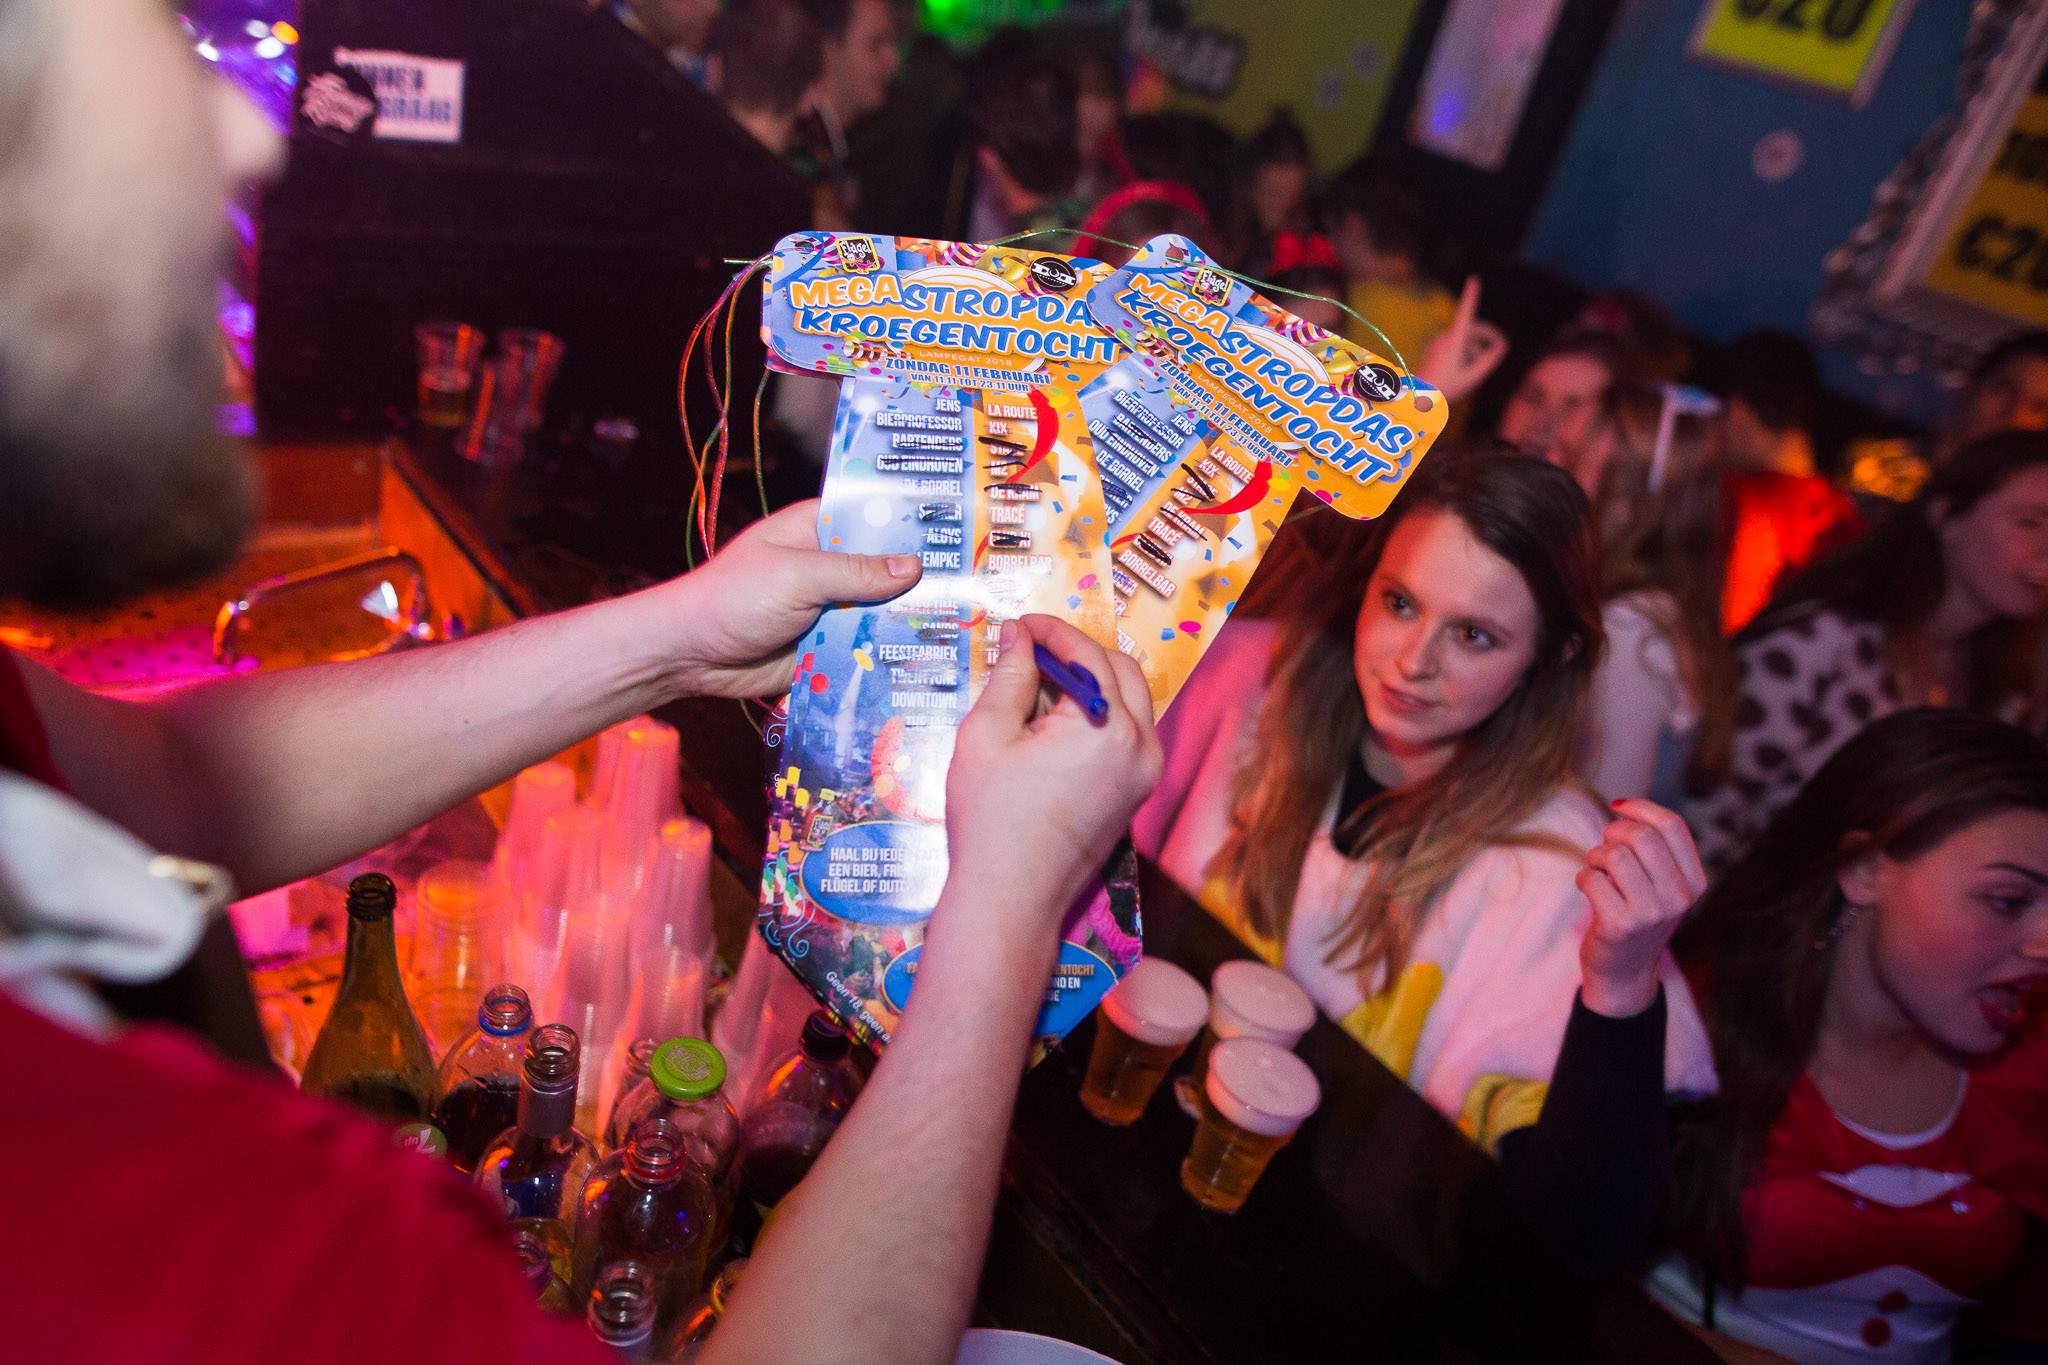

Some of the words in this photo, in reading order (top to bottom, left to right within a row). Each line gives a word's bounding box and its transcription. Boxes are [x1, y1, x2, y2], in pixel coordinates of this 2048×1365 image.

[789, 275, 1095, 329] MEGASTROPDA
[799, 308, 1119, 363] KROEGENTOCHT
[919, 350, 981, 364] LAMPEGAT
[985, 356, 1013, 367] 2018
[885, 357, 950, 375] ZONDAG
[954, 364, 970, 377] 11
[973, 366, 1051, 385] FEBRUARI
[911, 373, 932, 382] VAN
[959, 378, 978, 387] TOT
[1008, 383, 1030, 393] UUR
[1117, 289, 1394, 485] KROEGENTOCHT
[935, 399, 961, 412] JENS
[988, 404, 1002, 418] LA
[1003, 405, 1038, 419] ROUTE
[1160, 359, 1215, 405] ZONDAG
[1213, 401, 1230, 417] 11
[1227, 412, 1293, 467] FEBRUARI
[1198, 373, 1249, 414] LAMPEGAT
[1248, 414, 1273, 434] 2018
[876, 412, 963, 431] BIERPROFESSOR
[1113, 389, 1185, 449] BIERPROFESSOR
[1171, 414, 1197, 435] JENS
[1172, 383, 1191, 399] VAN
[1209, 411, 1226, 427] TOT
[1246, 442, 1266, 460] UUR
[1088, 419, 1110, 442] OUD
[1095, 449, 1113, 467] DE
[1107, 459, 1145, 493] BORREL
[1210, 445, 1226, 465] LA
[1222, 454, 1254, 484] ROUTE
[990, 504, 1025, 523] TRACÉ
[926, 527, 962, 544] ALOYS
[917, 552, 961, 568] EMPKE
[1119, 549, 1177, 598] BORRELBAR
[892, 691, 957, 709] DOWNTOWN
[830, 847, 859, 861] HAAL
[862, 847, 877, 862] BIJ
[880, 847, 904, 862] IEDE
[828, 863, 850, 877] EEN
[852, 863, 881, 879] BIER,
[820, 877, 861, 893] FLÜGEL
[862, 880, 876, 893] OF
[1068, 976, 1080, 989] EN
[826, 971, 850, 997] Geen
[859, 1010, 885, 1034] geen
